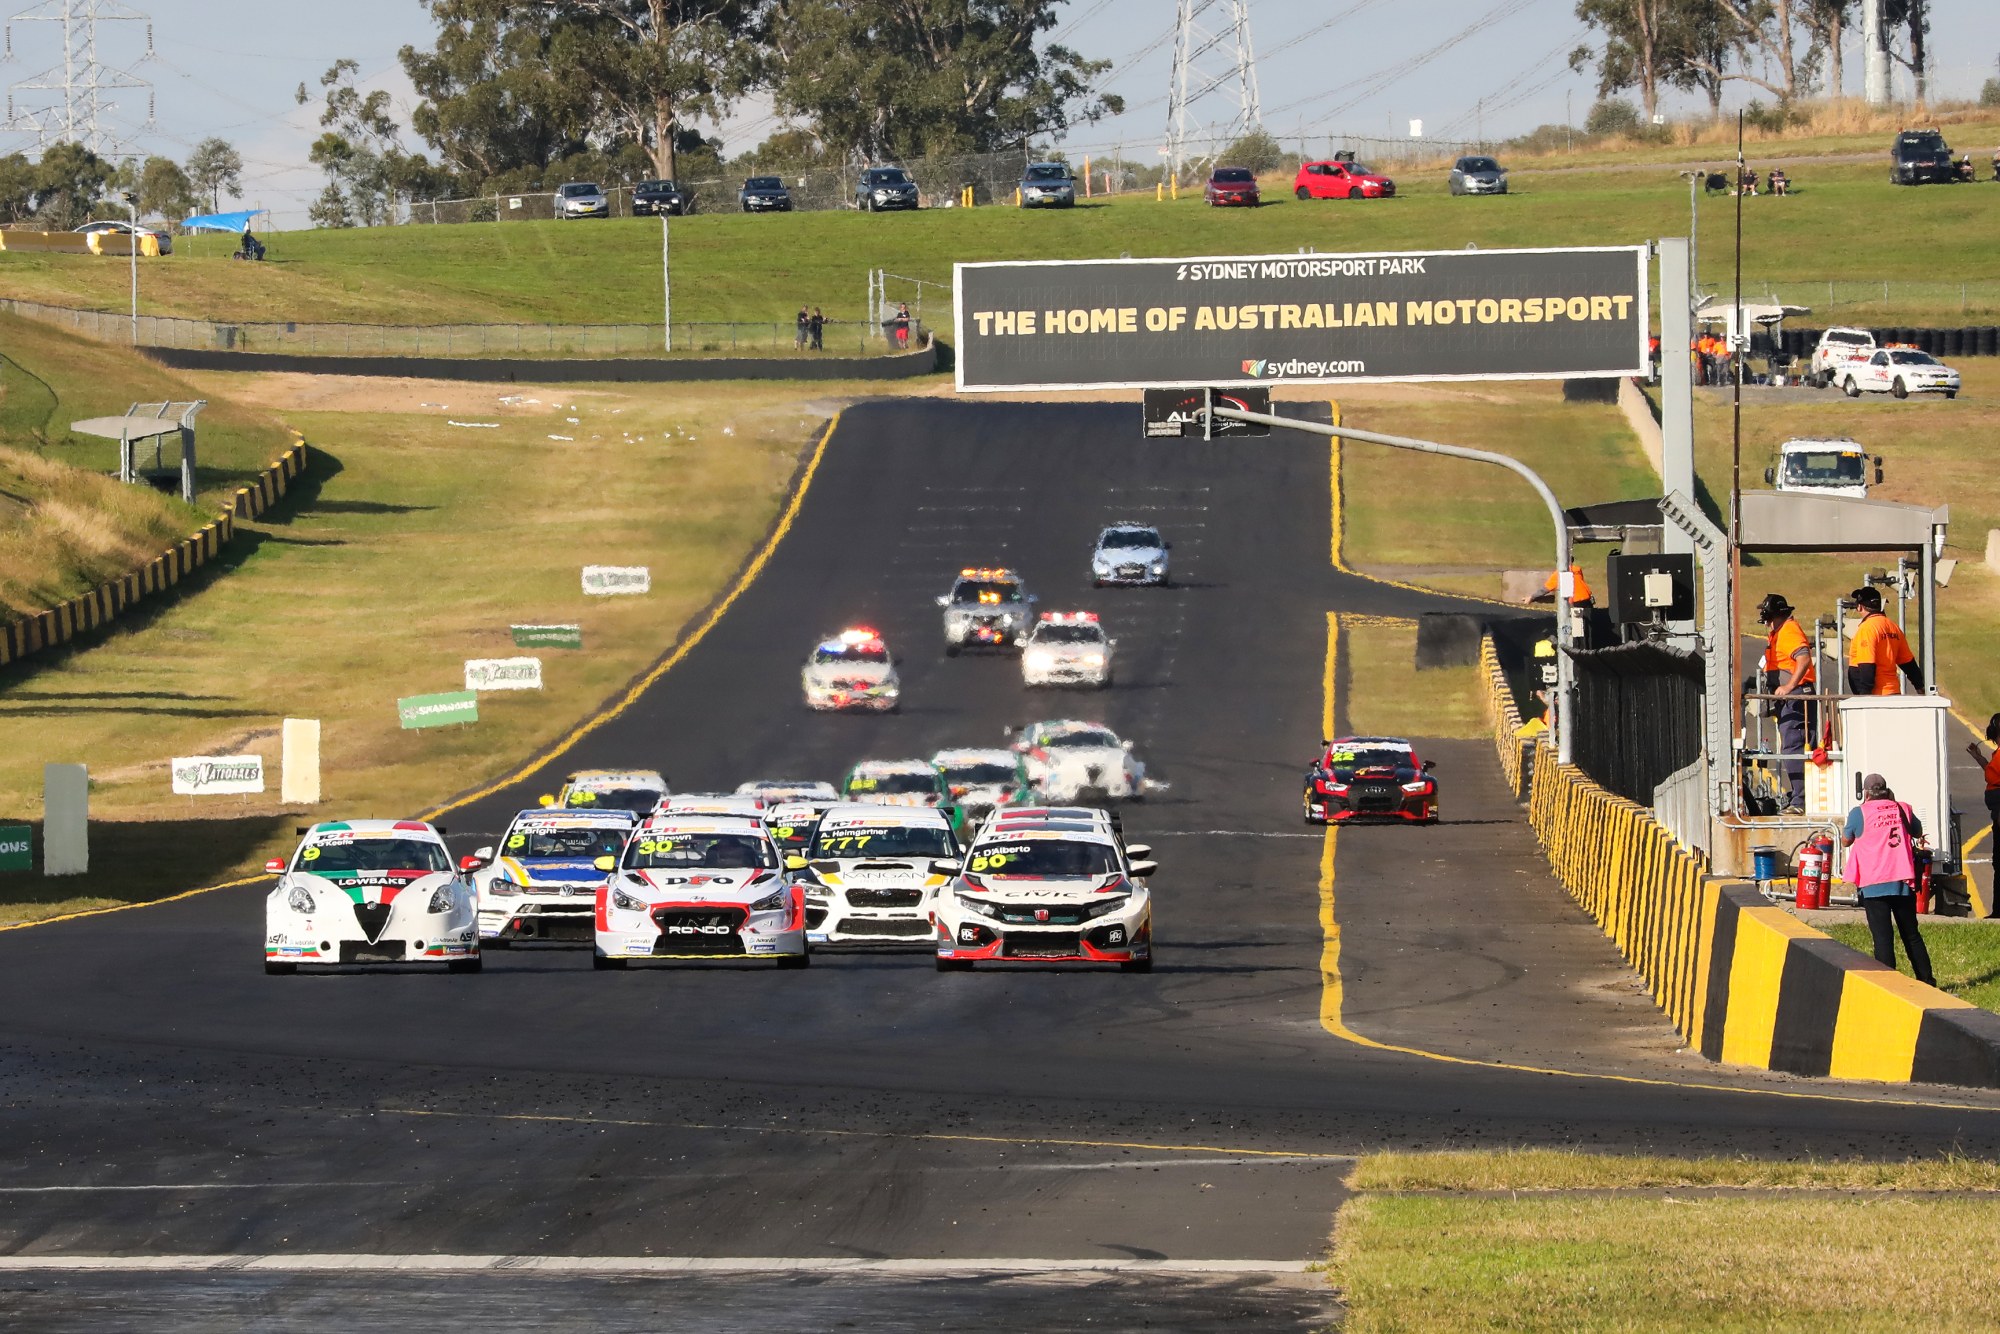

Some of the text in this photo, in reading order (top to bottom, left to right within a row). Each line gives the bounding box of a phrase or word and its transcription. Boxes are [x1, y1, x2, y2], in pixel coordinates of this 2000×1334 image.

[1190, 258, 1426, 280] SYDNEY MOTORSPORT PARK
[973, 295, 1633, 336] THE HOME OF AUSTRALIAN MOTORSPORT
[1267, 359, 1365, 377] sydney.com
[524, 828, 557, 836] Bright
[656, 834, 692, 842] Brown
[832, 828, 889, 839] Heimgartner
[1887, 826, 1902, 848] 5
[507, 834, 526, 848] 8
[639, 840, 673, 854] 30
[820, 836, 872, 850] 777
[303, 847, 321, 861] 9
[983, 845, 1031, 857] D'Alberto
[971, 854, 1007, 872] 50
[338, 877, 407, 886] LOWBAKE
[665, 876, 734, 885] DFO
[842, 871, 926, 879] KANGAN
[668, 926, 730, 935] RONDO
